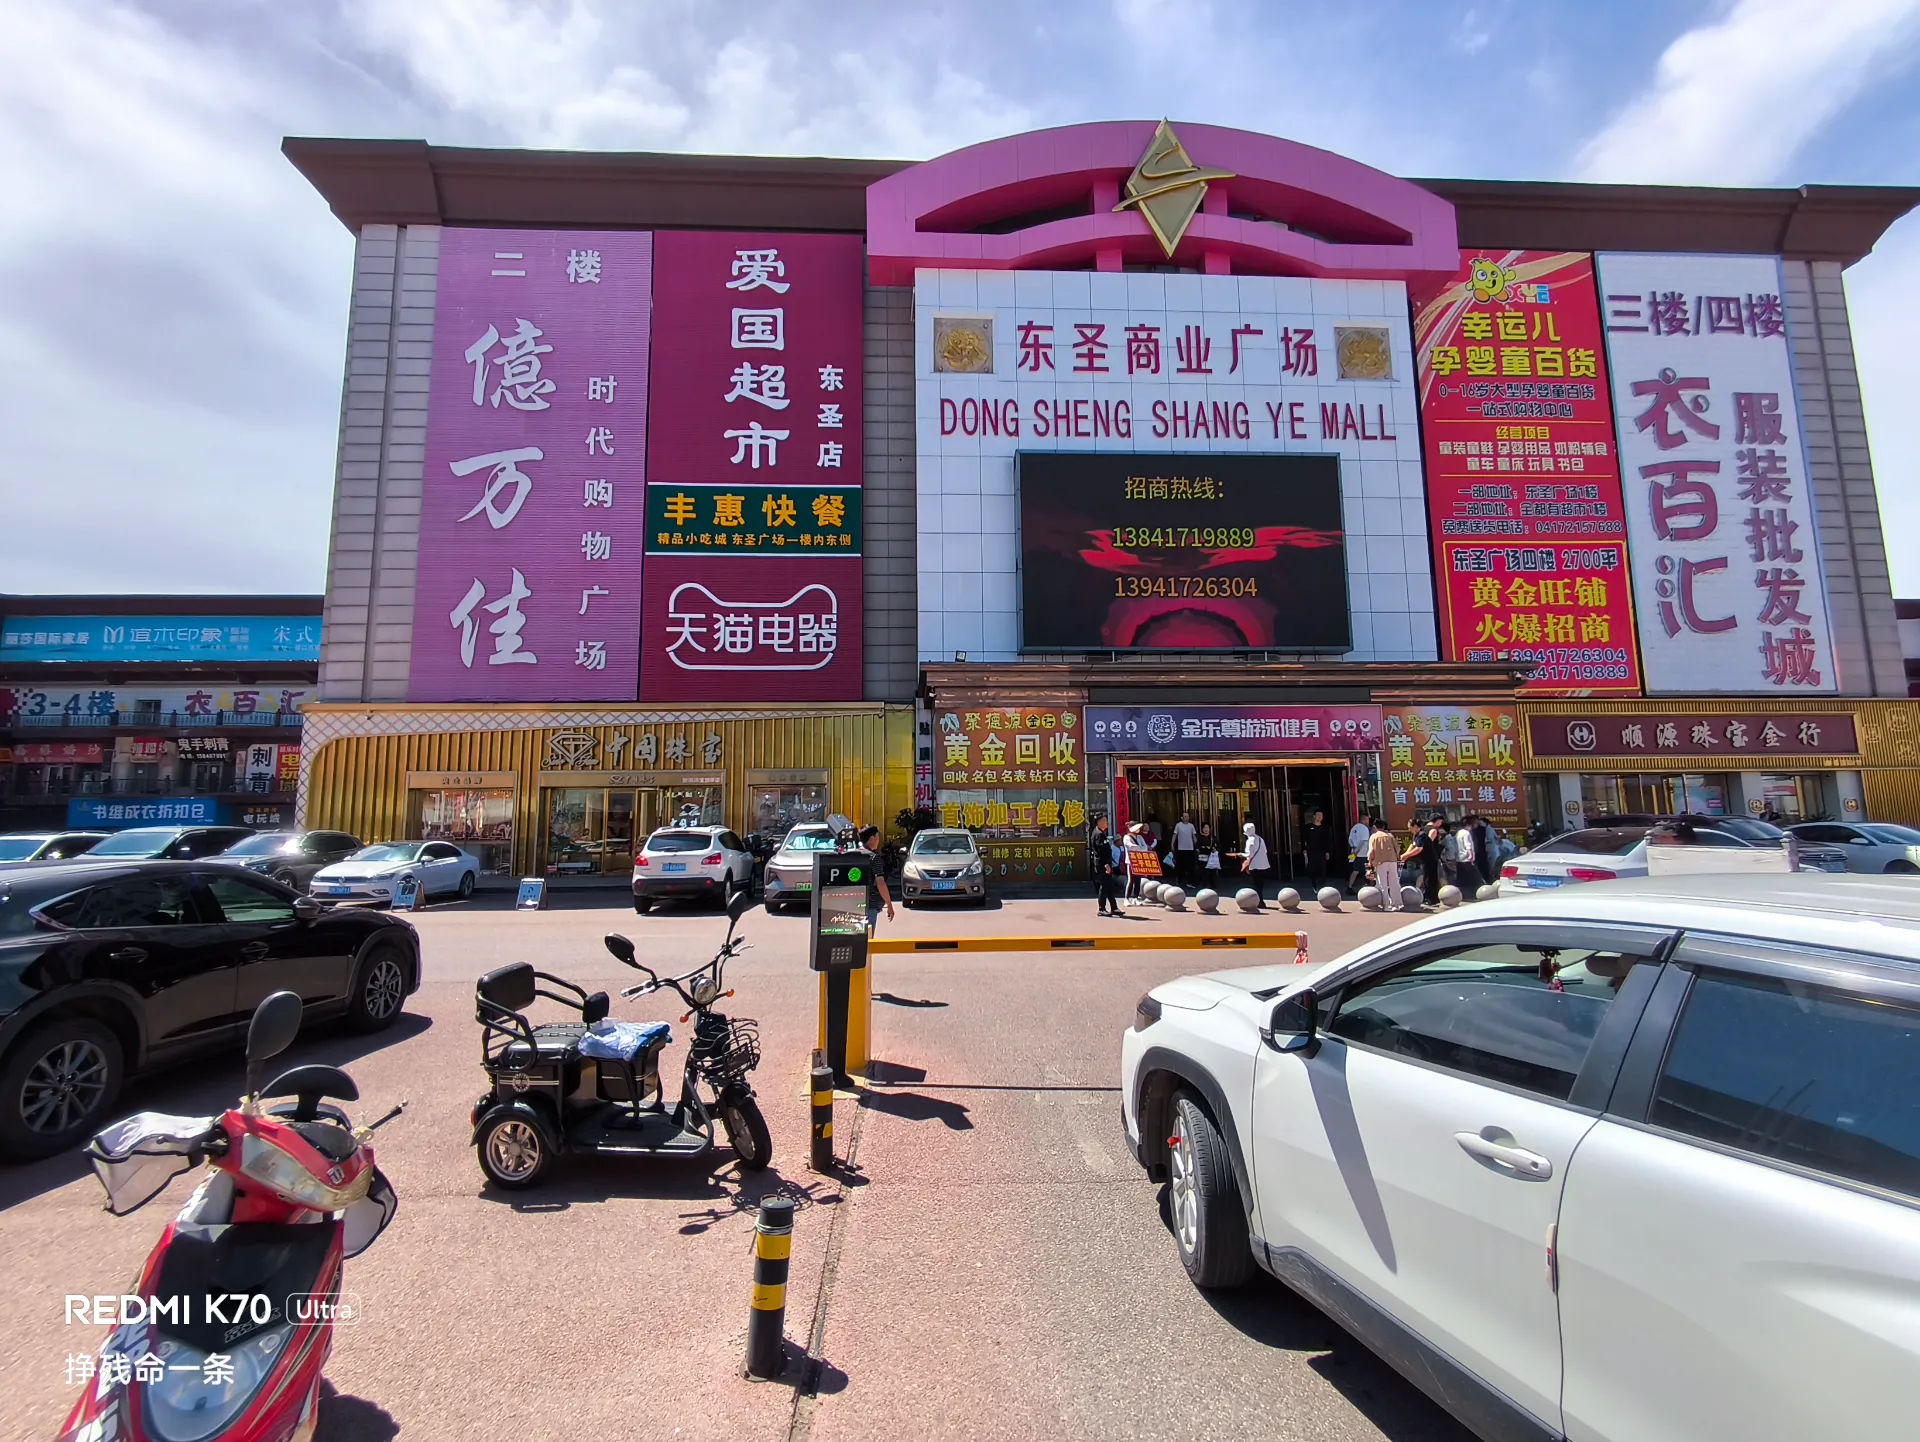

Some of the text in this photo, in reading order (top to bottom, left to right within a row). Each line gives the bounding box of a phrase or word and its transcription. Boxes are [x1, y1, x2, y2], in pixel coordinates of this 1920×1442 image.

[491, 249, 602, 284] 二楼
[1462, 311, 1562, 342] 幸运儿
[1607, 291, 1786, 338] 三楼/四楼
[723, 248, 791, 470] 爱国超市
[1016, 319, 1319, 378] 东圣商业广场
[1430, 346, 1598, 378] 孕婴童百货
[816, 364, 844, 468] 东圣店
[939, 397, 1397, 441] DONG SHENG SHANG YE MALL
[1467, 402, 1574, 417] 一站式购物中心
[1495, 426, 1550, 440] 经营项目
[1438, 441, 1494, 455] 童装童鞋
[1497, 441, 1551, 456] 孕婴用品
[1466, 457, 1585, 471] 童车 童床 玩具 书包
[448, 317, 557, 669] 億万佳
[1630, 367, 1739, 640] 衣百汇
[574, 375, 618, 671] 时代购物广场
[663, 492, 847, 528] 丰惠快餐
[657, 532, 853, 548] 精品小吃城 东圣广场一楼内东侧
[1112, 528, 1256, 548] 13841719889
[1731, 391, 1822, 687] 服装批发城
[1452, 548, 1618, 571] 东圣广场四楼 2700平
[1114, 577, 1258, 598] 13941726304
[1469, 577, 1608, 608] 黄金旺铺
[273, 625, 322, 643] 宋式
[665, 612, 838, 655] 天猫电器
[1475, 612, 1611, 645] 火爆招商
[1467, 648, 1628, 663] 招商 3941726304
[1525, 664, 1630, 680] 841719889
[28, 690, 116, 716] 3-4楼
[964, 711, 1057, 730] 聚德源金行
[1181, 718, 1320, 738] 金乐尊游泳健身
[1622, 720, 1821, 748] 顺源珠宝金行
[178, 737, 230, 752] 鬼手刺青
[605, 731, 722, 766] 中国珠宝
[943, 732, 1077, 767] 黄金回收
[1388, 733, 1516, 768] 黄金回收
[251, 746, 273, 793] 刺青
[943, 770, 1079, 784] 回收 名包 名表 钻石 K金
[1390, 769, 1517, 783] 回收 名包 名表 钻石 K金
[1391, 786, 1517, 804] 首饰加工维修
[938, 799, 1086, 829] 首饰加工维修
[1014, 847, 1032, 858] 定制
[830, 868, 840, 882] P
